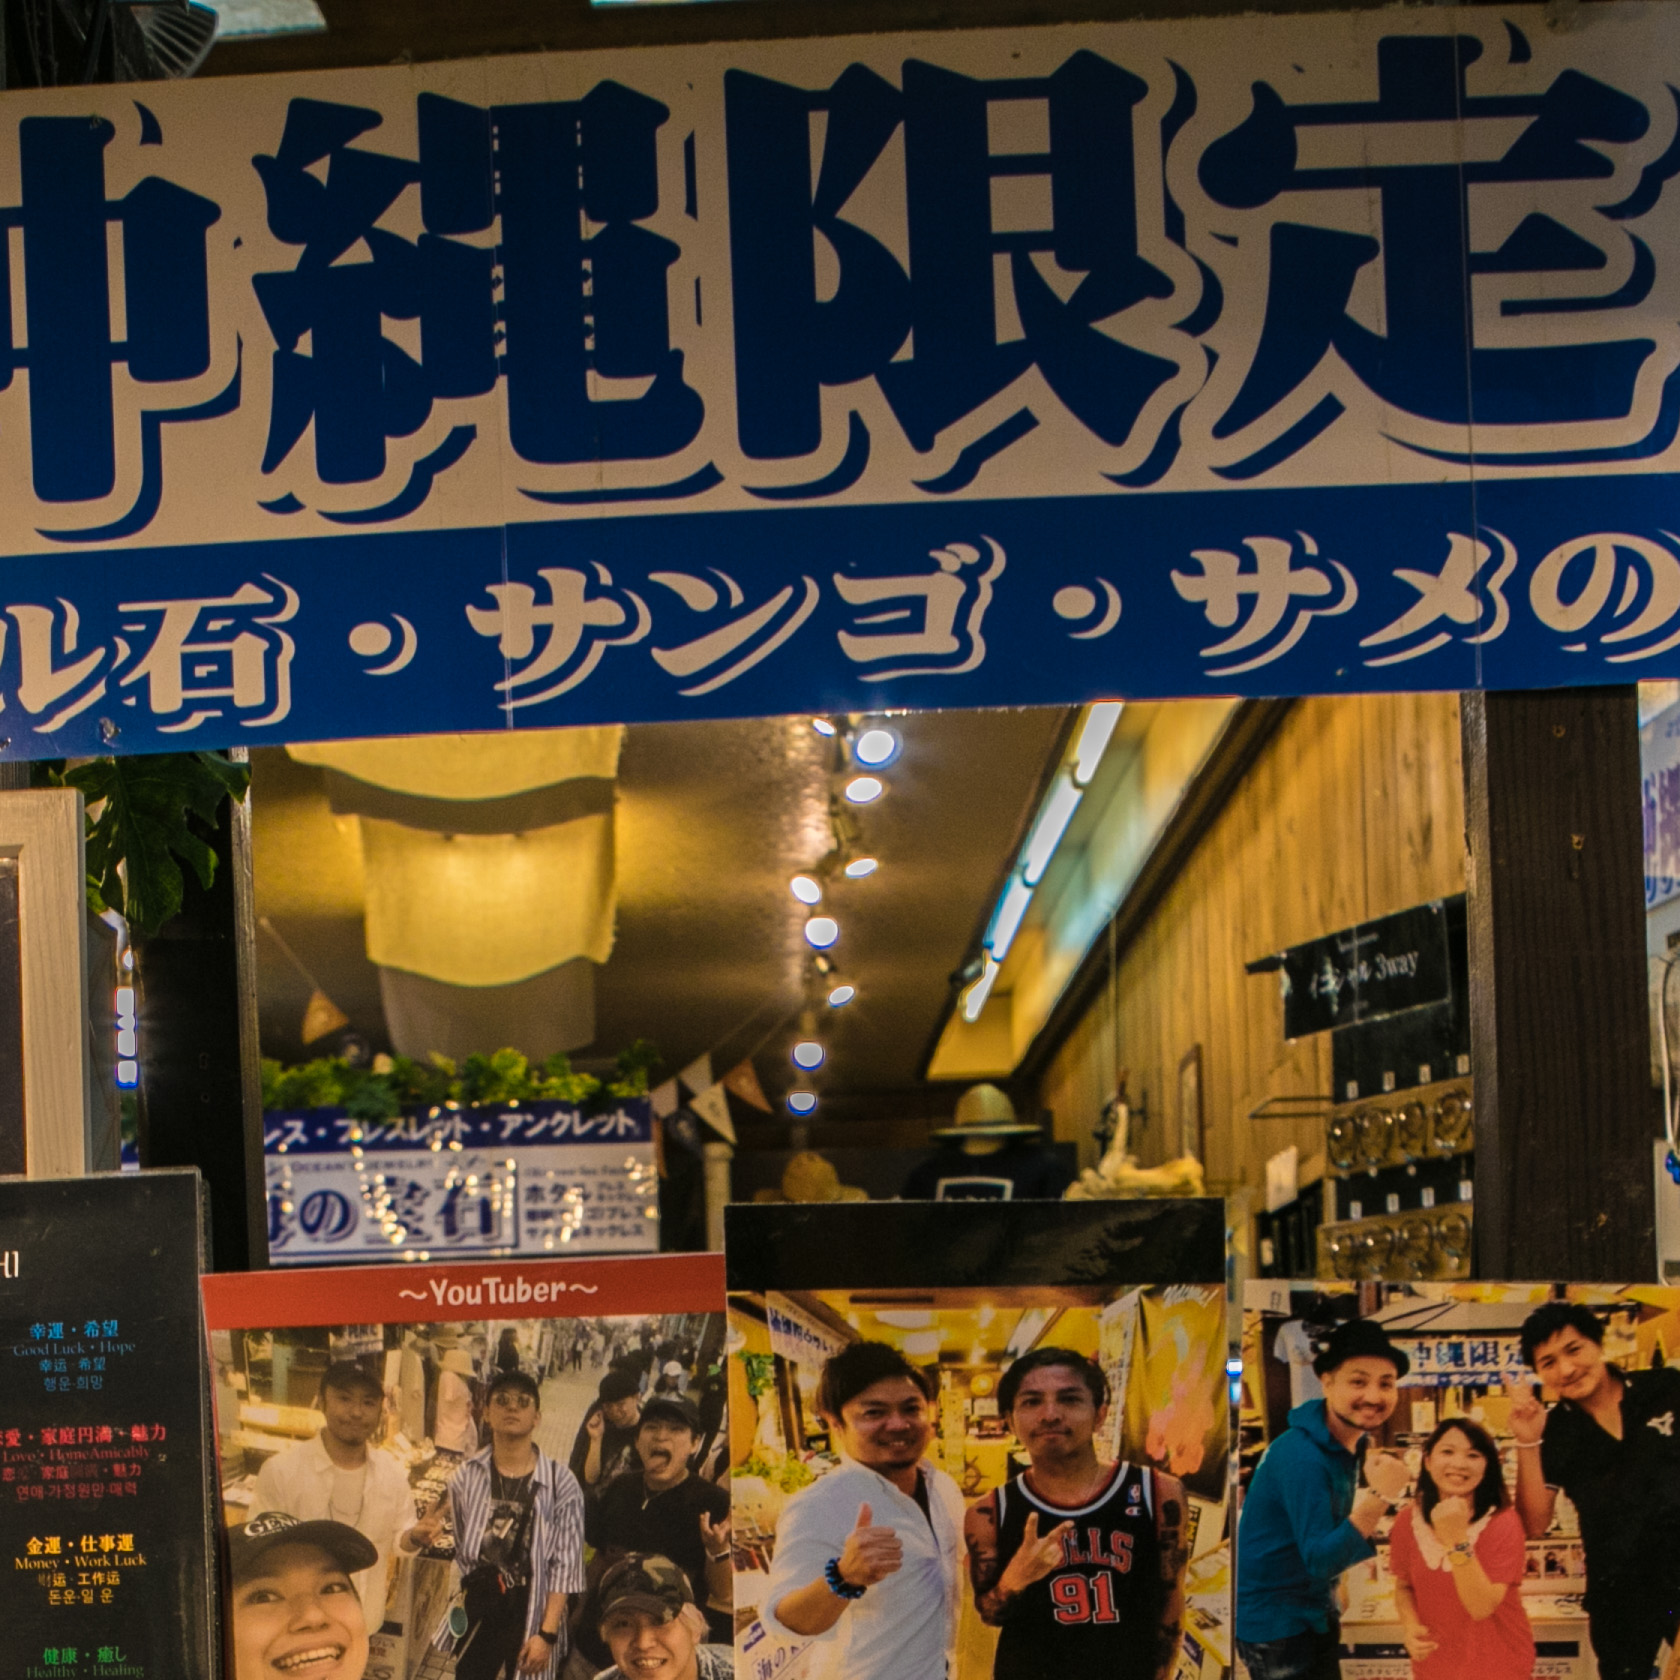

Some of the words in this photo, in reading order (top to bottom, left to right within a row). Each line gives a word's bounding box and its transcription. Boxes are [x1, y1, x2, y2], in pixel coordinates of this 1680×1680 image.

[30, 1320, 118, 1340] 幸運・希望
[27, 1533, 134, 1555] 金運・仕事運
[15, 1557, 60, 1571] Money
[74, 1554, 111, 1568] Work
[114, 1554, 147, 1567] Luck
[1051, 1572, 1119, 1625] 91
[44, 1646, 127, 1665] 健康・癒し
